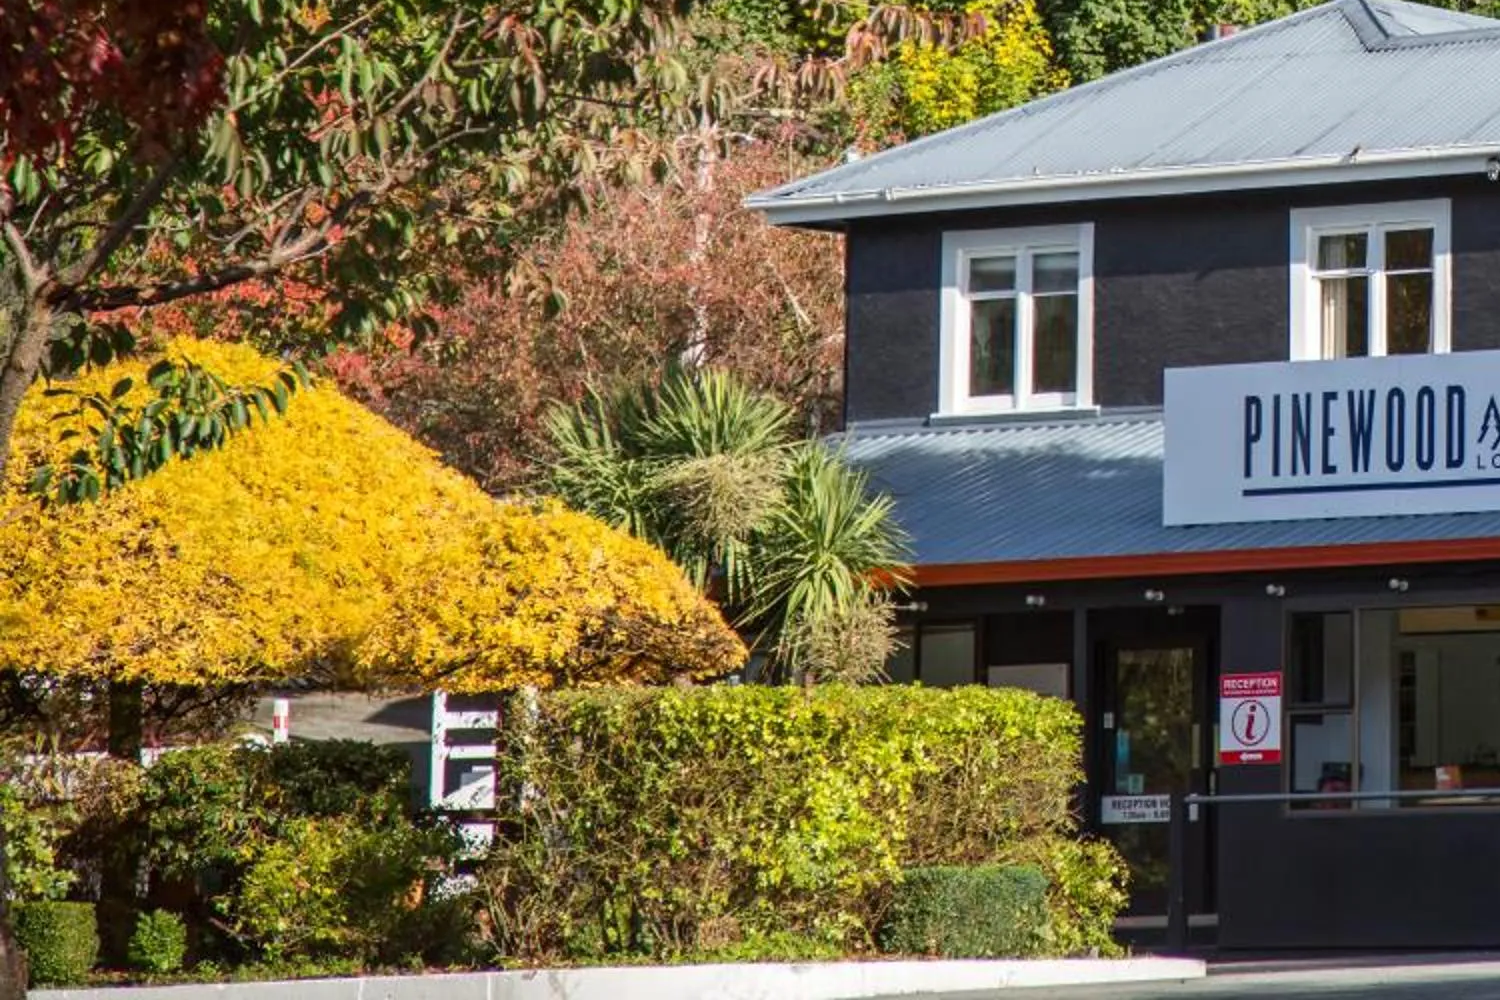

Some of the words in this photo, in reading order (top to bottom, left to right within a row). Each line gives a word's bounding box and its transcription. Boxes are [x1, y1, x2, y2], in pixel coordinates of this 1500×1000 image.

[1243, 385, 1466, 479] PINEWOOD
[1223, 678, 1278, 690] RECEPTION
[1111, 799, 1157, 809] RECEPTION
